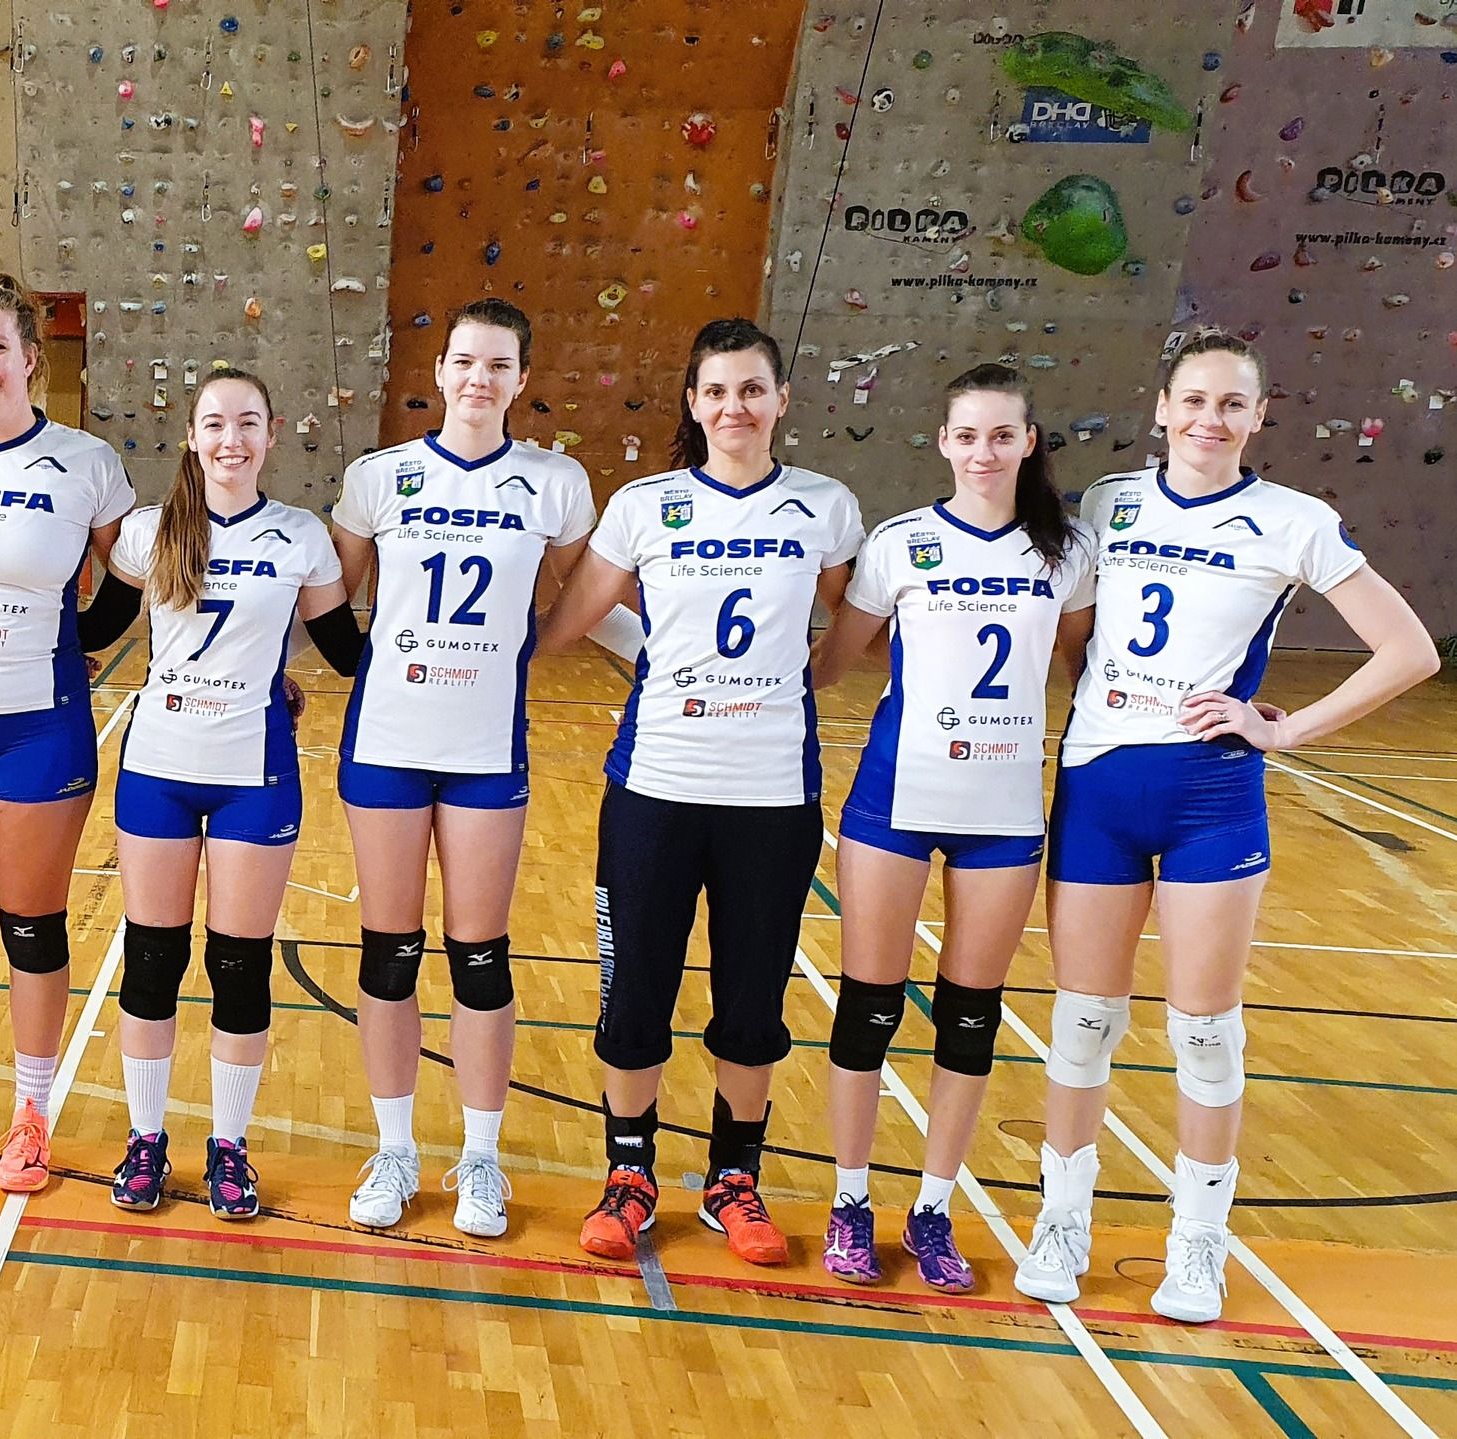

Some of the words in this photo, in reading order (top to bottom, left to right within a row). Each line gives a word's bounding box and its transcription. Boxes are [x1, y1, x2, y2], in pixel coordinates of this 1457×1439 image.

[1317, 167, 1445, 196] PILKA
[845, 205, 968, 232] PILKA
[400, 507, 526, 531] FOSFA
[397, 528, 420, 539] Life
[423, 530, 483, 544] Science
[671, 539, 805, 559] FOSFA
[207, 559, 277, 578] SFA
[670, 565, 696, 577] Life
[700, 565, 763, 576] Science
[1128, 557, 1188, 576] Science
[203, 582, 238, 590] ence
[420, 551, 493, 626] 12
[927, 577, 1055, 599] FOSFA
[928, 600, 953, 612] Life
[957, 600, 1017, 612] Science
[716, 587, 756, 659] 6
[1127, 582, 1174, 657] 3
[187, 599, 235, 662] 7
[426, 639, 499, 652] GUMOTEX
[971, 624, 1012, 700] 2
[429, 666, 479, 679] SCHMIDT
[705, 674, 782, 686] GUMOTEX
[183, 675, 247, 690] GUMOTEX
[429, 678, 475, 687] REALITY
[185, 697, 228, 712] SCHMIDT
[709, 702, 763, 712] SCHMIDT
[183, 708, 224, 718] REALITY
[968, 716, 1033, 725] GUMOTEX
[974, 742, 1019, 753] SCHMIDT
